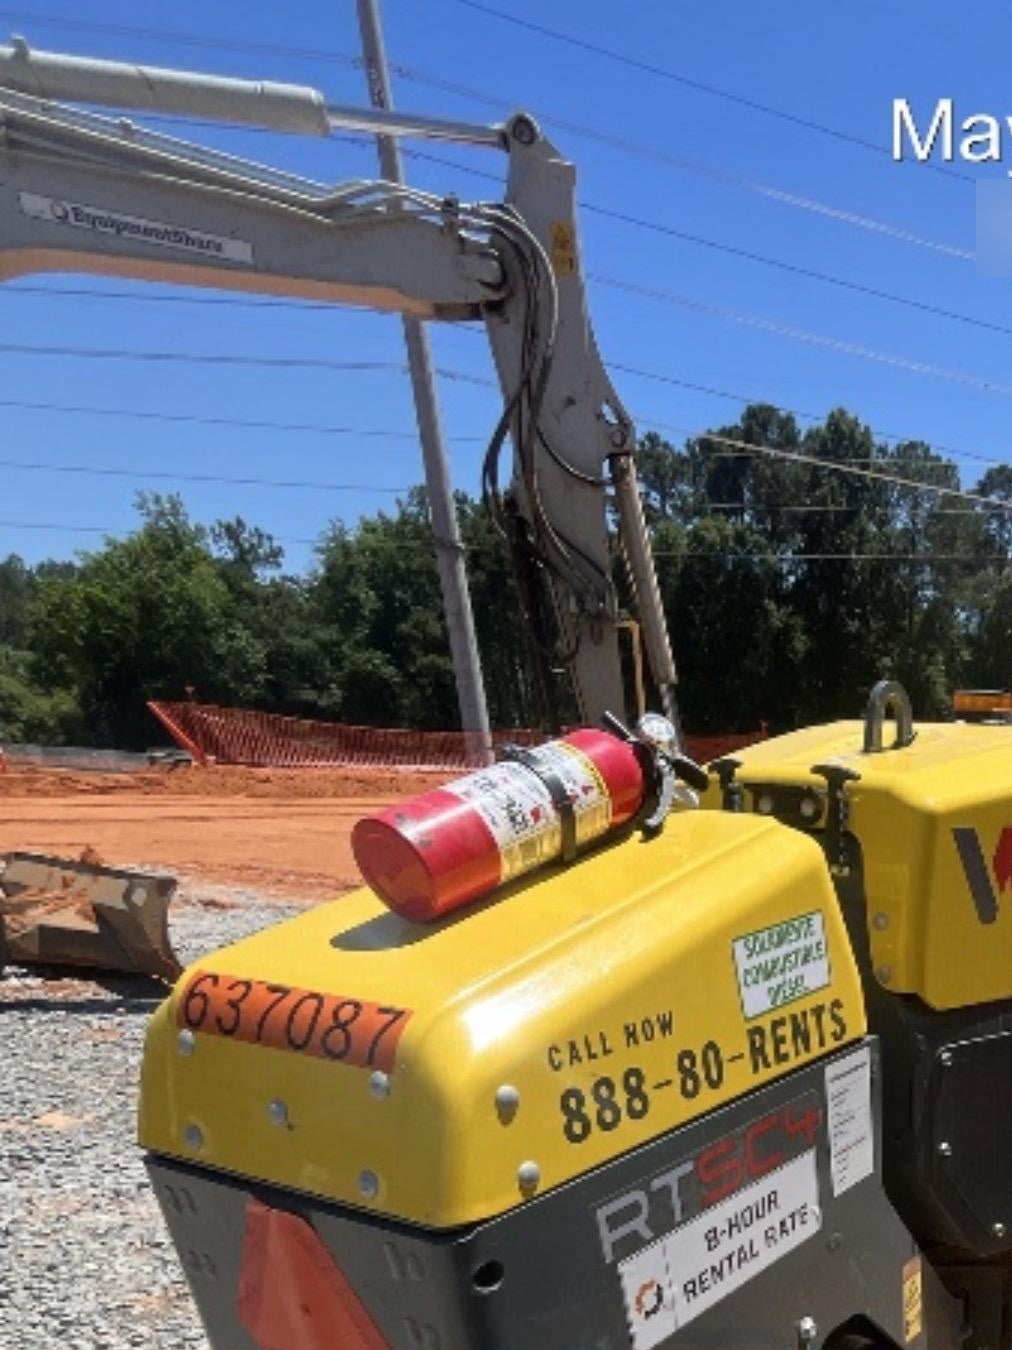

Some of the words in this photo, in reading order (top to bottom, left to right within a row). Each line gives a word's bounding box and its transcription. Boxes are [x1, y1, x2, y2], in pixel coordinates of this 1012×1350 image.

[183, 973, 406, 1066] 637087
[547, 1029, 614, 1072] CALL
[624, 1011, 674, 1047] NOW
[560, 999, 848, 1144] 888-80-RENTS
[683, 1238, 760, 1302] RENTAL
[764, 1202, 808, 1249] RATE
[704, 1190, 781, 1252] 8-HOUR
